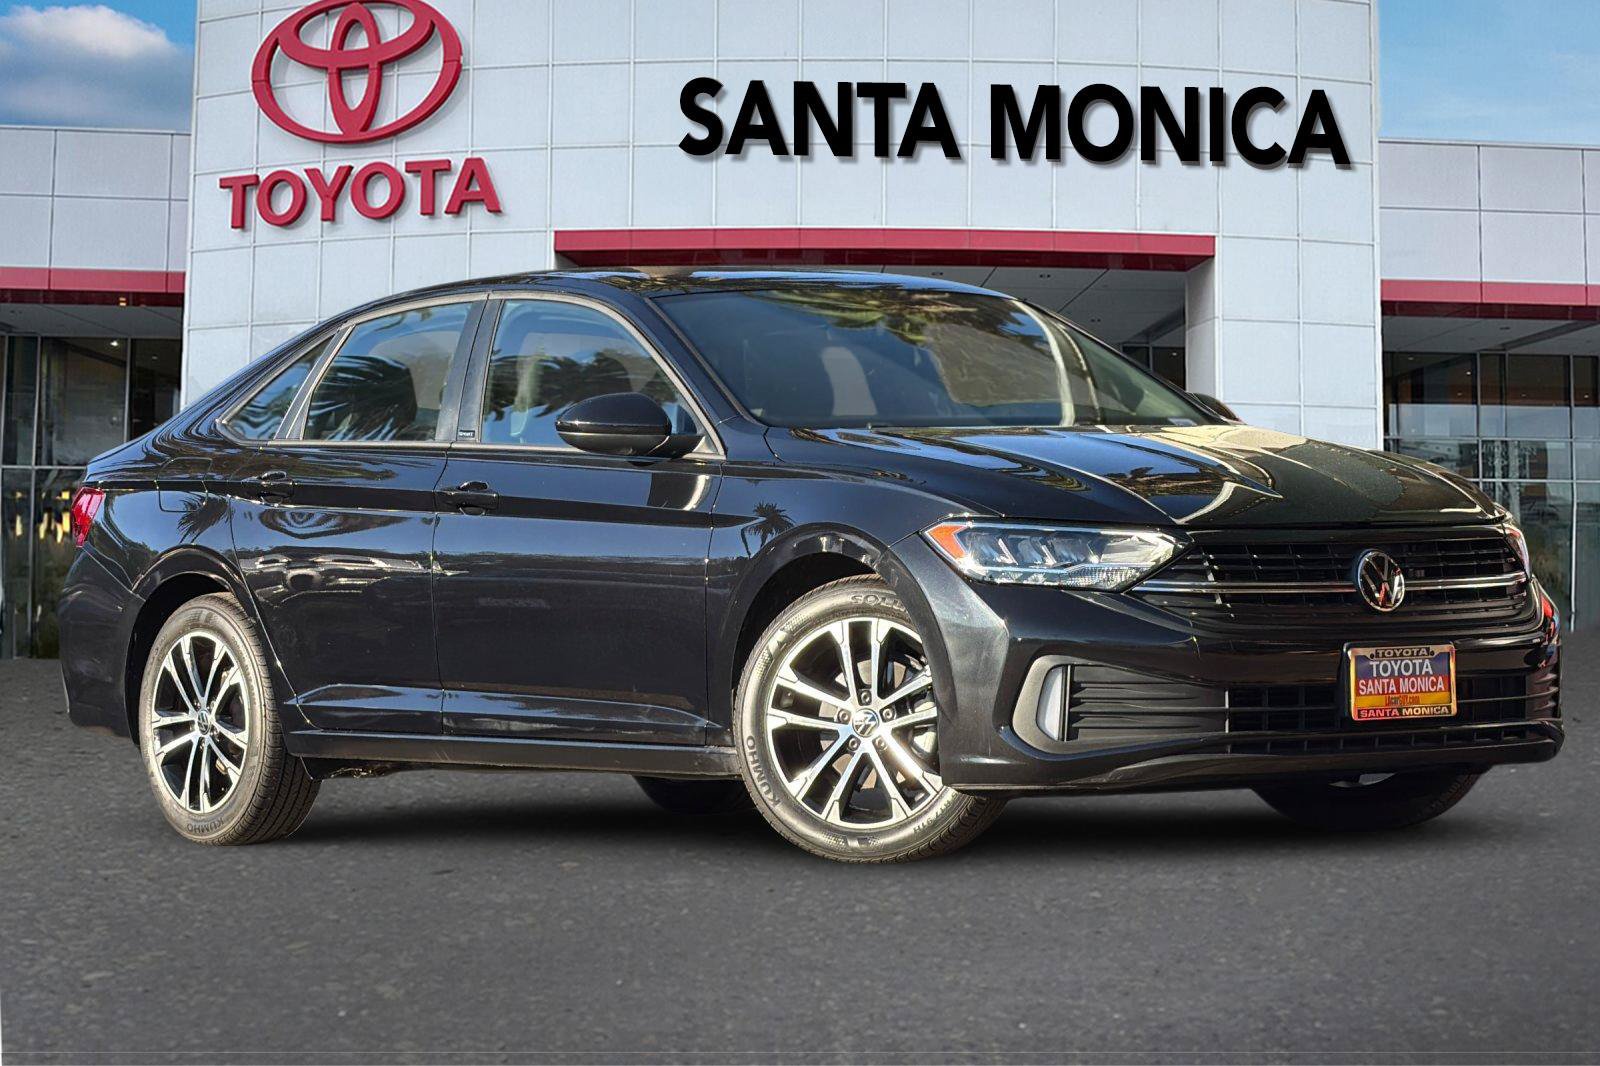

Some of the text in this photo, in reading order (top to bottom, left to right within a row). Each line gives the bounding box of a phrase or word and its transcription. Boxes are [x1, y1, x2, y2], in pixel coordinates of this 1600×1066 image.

[678, 77, 1351, 167] SANTA MONICA
[219, 157, 502, 229] TOYOTA
[1377, 648, 1428, 657] TOYOTA
[1369, 659, 1433, 676] TOYOTA
[1359, 676, 1445, 695] SANTA MONICA
[1360, 706, 1449, 718] SANTA MONICA
[746, 735, 781, 808] KUMHO
[187, 817, 224, 834] KUMHO
